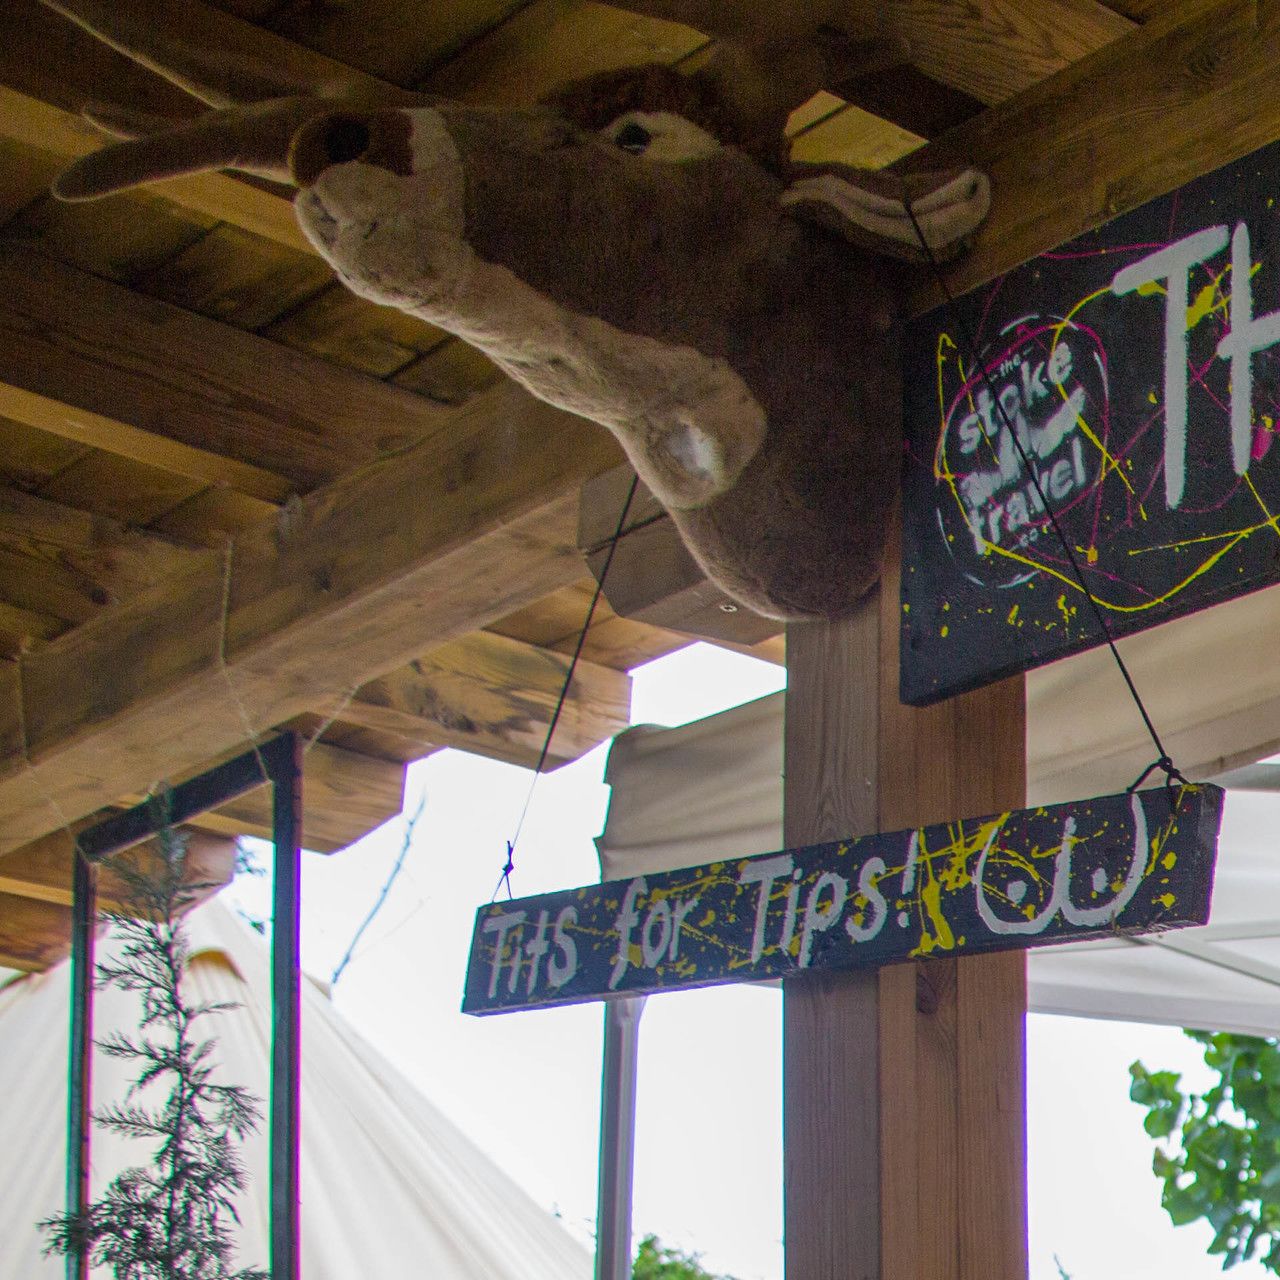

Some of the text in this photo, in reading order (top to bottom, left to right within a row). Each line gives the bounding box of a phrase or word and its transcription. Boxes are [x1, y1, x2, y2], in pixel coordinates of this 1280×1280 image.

[959, 343, 1073, 454] stoke
[970, 437, 1086, 555] travel
[608, 877, 698, 990] for
[740, 829, 921, 968] Tips!
